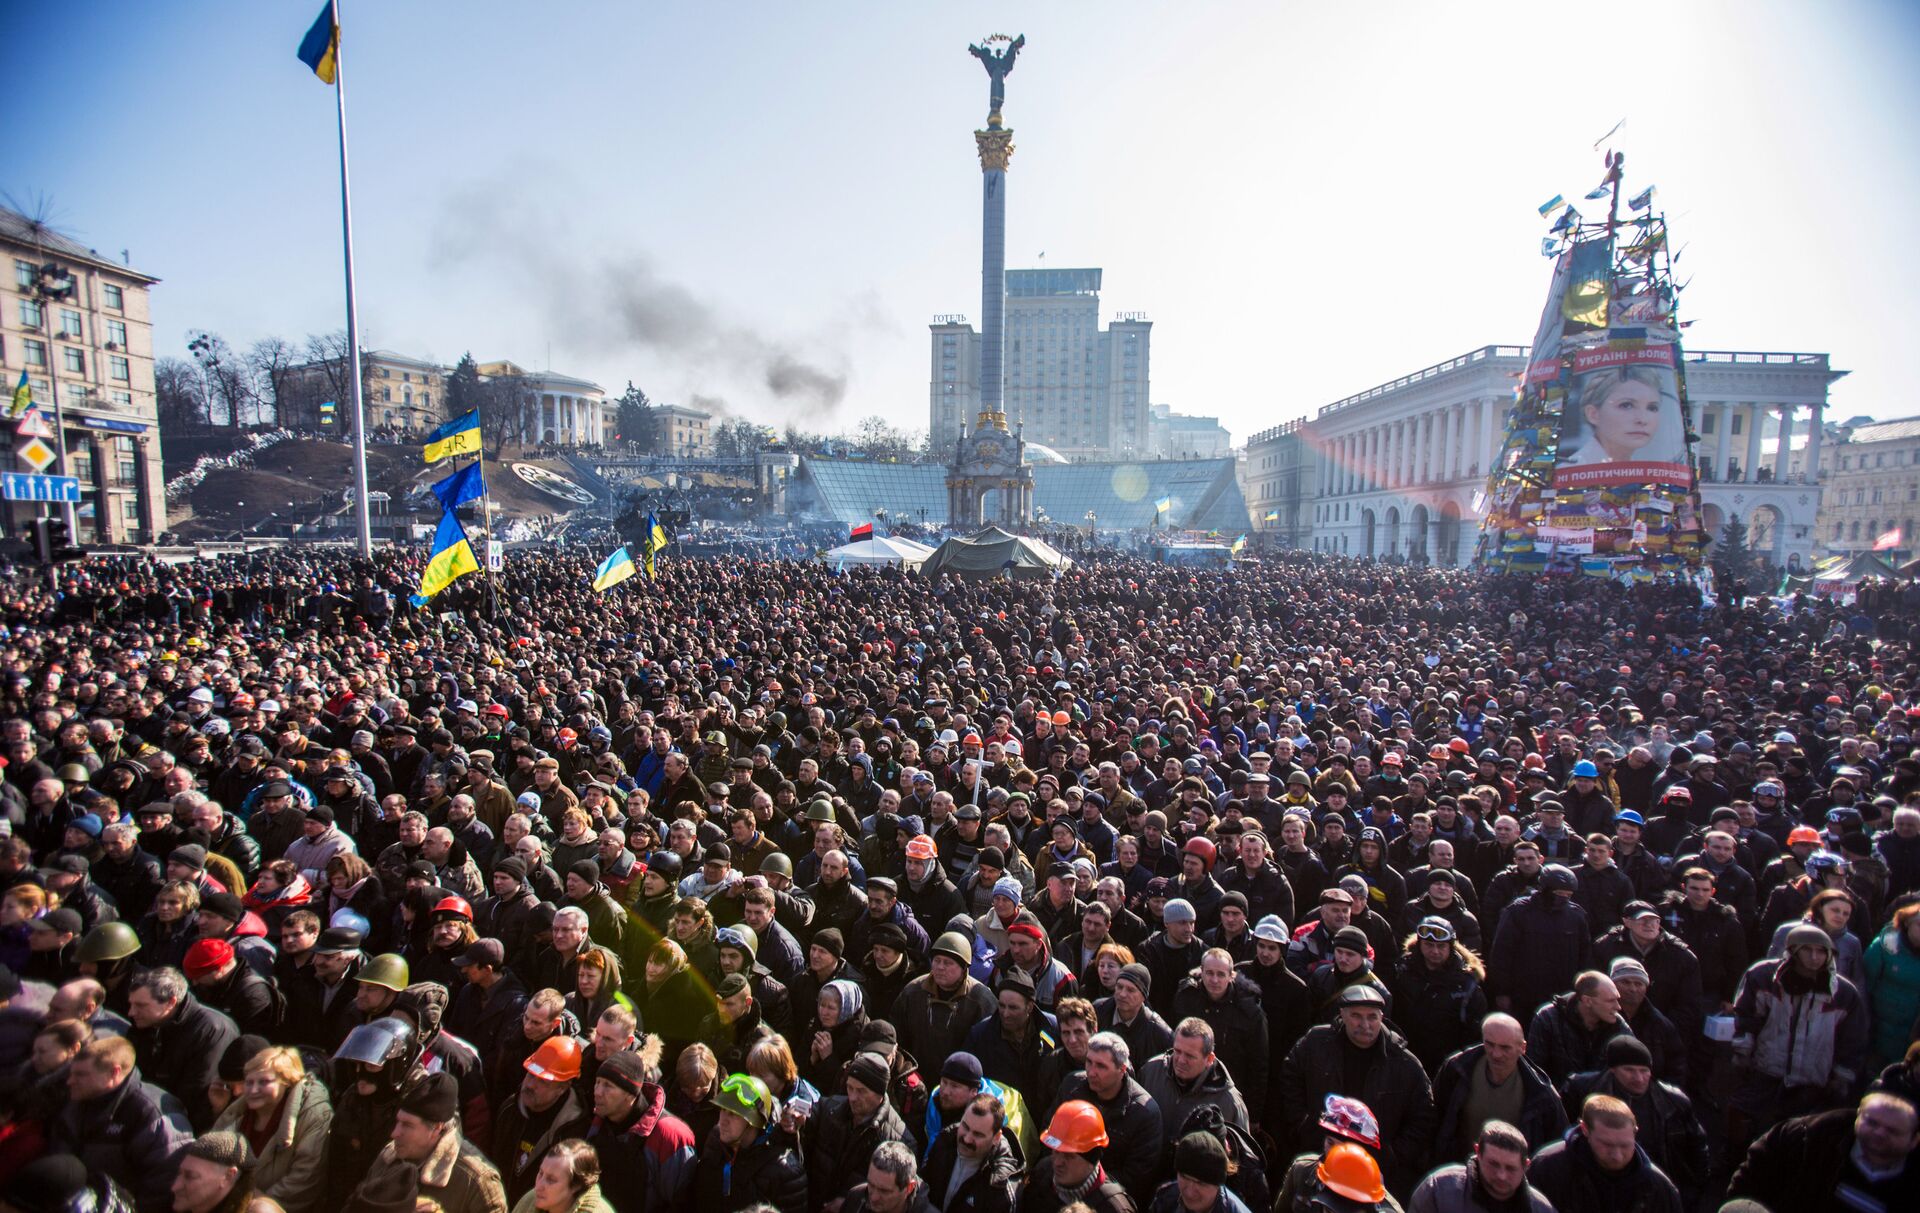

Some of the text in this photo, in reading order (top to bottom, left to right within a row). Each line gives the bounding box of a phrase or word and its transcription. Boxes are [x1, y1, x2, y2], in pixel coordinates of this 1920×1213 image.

[933, 314, 967, 323] ГОТЕЛЬ
[1116, 311, 1149, 320] HOTEL
[1571, 468, 1645, 481] ПОЛІТИЧНИМ
